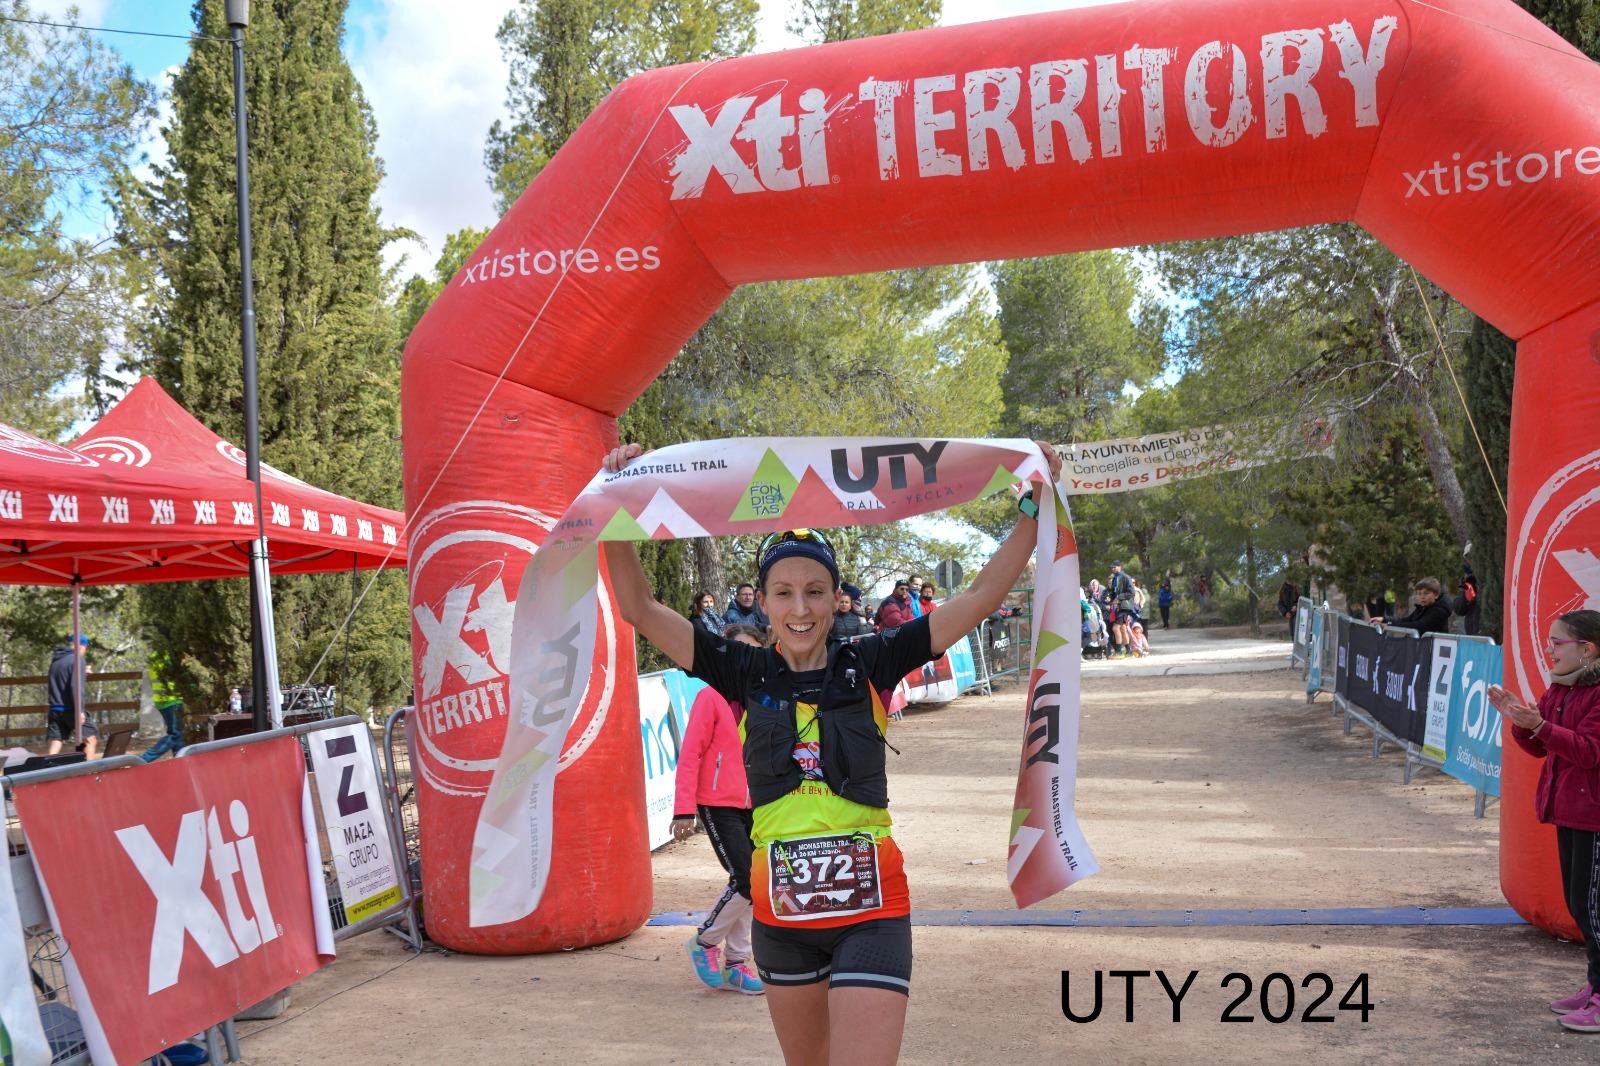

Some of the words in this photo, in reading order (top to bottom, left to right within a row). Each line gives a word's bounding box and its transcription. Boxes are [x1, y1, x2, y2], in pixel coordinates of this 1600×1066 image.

[664, 79, 832, 200] Xti
[859, 15, 1399, 181] TERRITORY
[460, 243, 661, 288] xtistore.es
[691, 459, 728, 472] TRAIL
[830, 440, 949, 493] UTY
[1071, 478, 1122, 489] Yecla
[1128, 473, 1149, 485] es
[48, 493, 79, 523] Xti
[101, 496, 130, 524] Xti
[149, 499, 176, 525] Xti
[192, 500, 218, 525] Xti
[231, 501, 255, 525] Xti
[752, 504, 780, 516] TAS
[838, 500, 883, 511] TRAIL
[906, 486, 954, 505] YECLA
[271, 501, 291, 527] Xti
[301, 508, 320, 531] Xti
[1026, 682, 1061, 770] UTY
[343, 820, 375, 845] MAZA
[1051, 776, 1062, 839] MONASTRELL
[1059, 839, 1079, 872] TRAIL
[349, 843, 379, 869] GRUPO
[792, 854, 854, 884] 372
[113, 799, 279, 996] Xti
